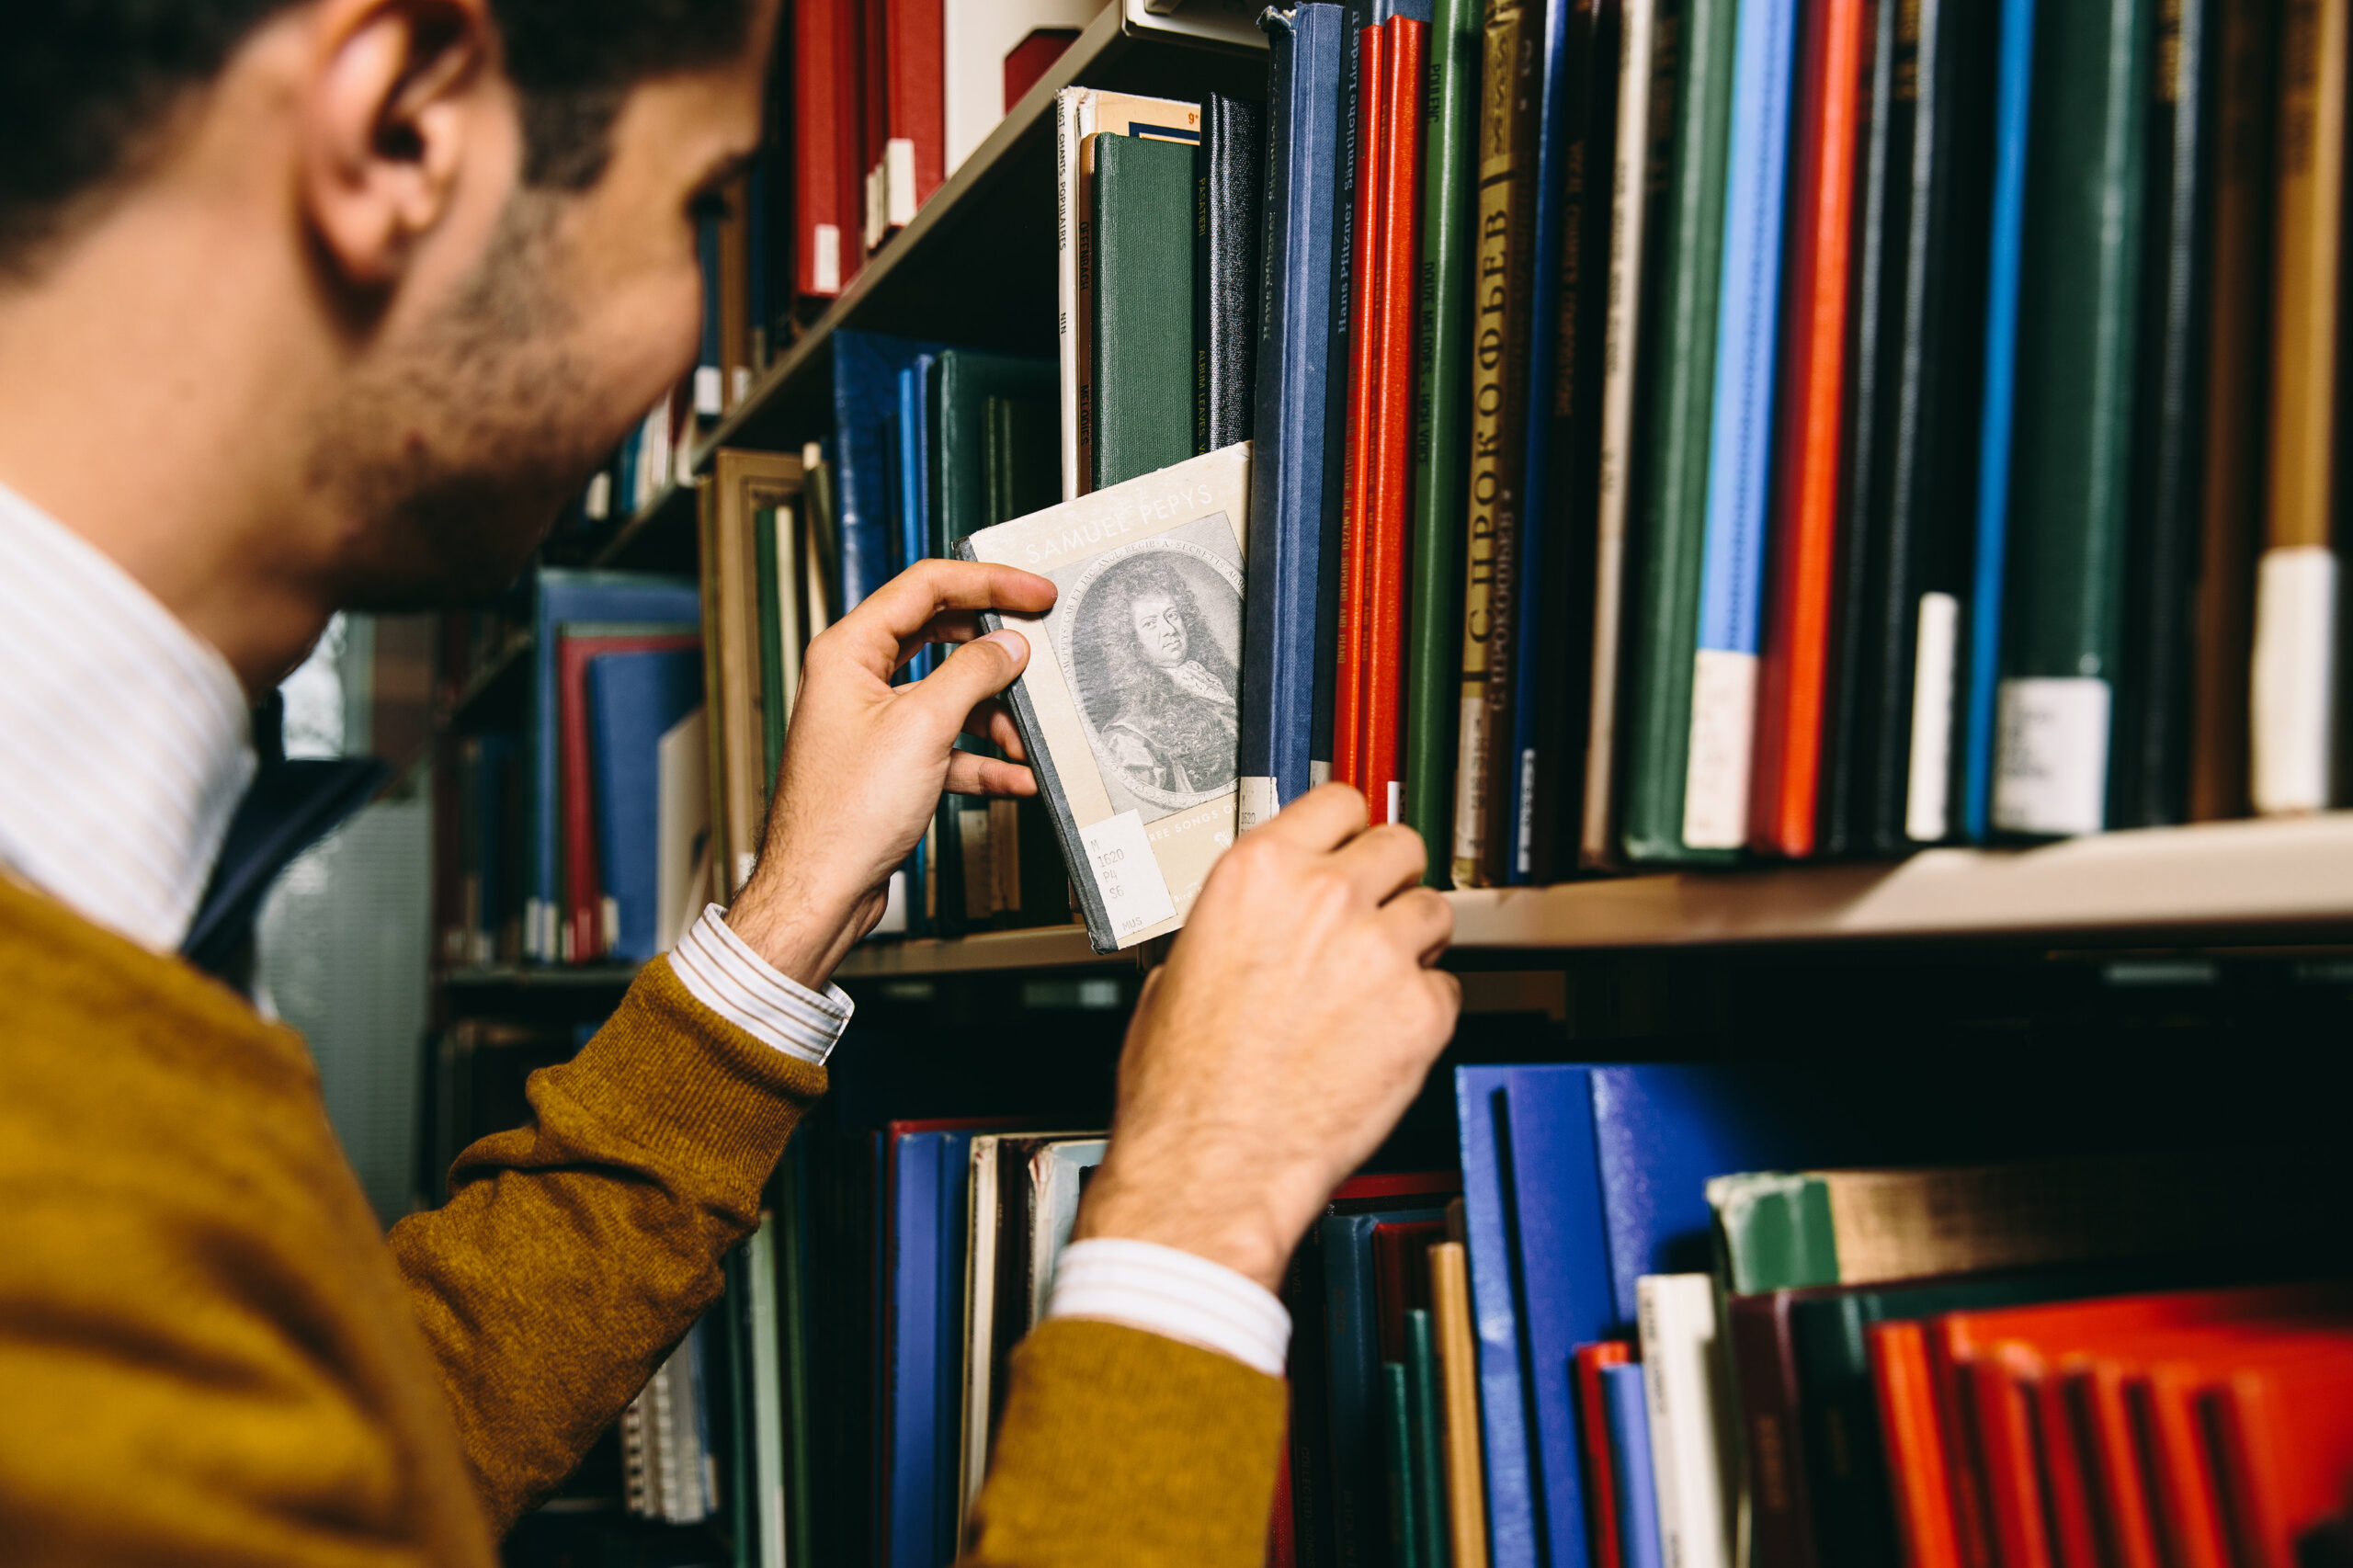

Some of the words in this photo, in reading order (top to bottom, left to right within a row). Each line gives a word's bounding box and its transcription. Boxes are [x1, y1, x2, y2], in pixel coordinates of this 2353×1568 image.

[1348, 28, 1360, 88] Lieder
[1058, 134, 1067, 176] CHANTS
[1344, 94, 1358, 190] Sämtliche
[1059, 181, 1067, 251] POPULAIRES
[1198, 177, 1207, 236] PASATIERI
[1079, 222, 1091, 291] OFFENBACH
[1339, 203, 1352, 278] Pfitzner
[1059, 312, 1068, 335] NIN
[1337, 283, 1348, 335] Hans
[1198, 349, 1206, 389] ALBUM
[1079, 384, 1091, 447] MELODIES
[1025, 513, 1131, 564] SAMUEL
[1139, 483, 1213, 525] PEPYS
[1341, 516, 1351, 551] MEZZO
[1339, 556, 1350, 602] SOPRANO
[1337, 608, 1348, 627] AND
[1336, 633, 1347, 665] PIANO
[1175, 810, 1219, 833] SONGS
[1090, 838, 1100, 853] M
[1097, 848, 1125, 869] 1620
[1102, 869, 1118, 883] P4
[1108, 885, 1125, 900] S6
[1121, 916, 1142, 931] MUS
